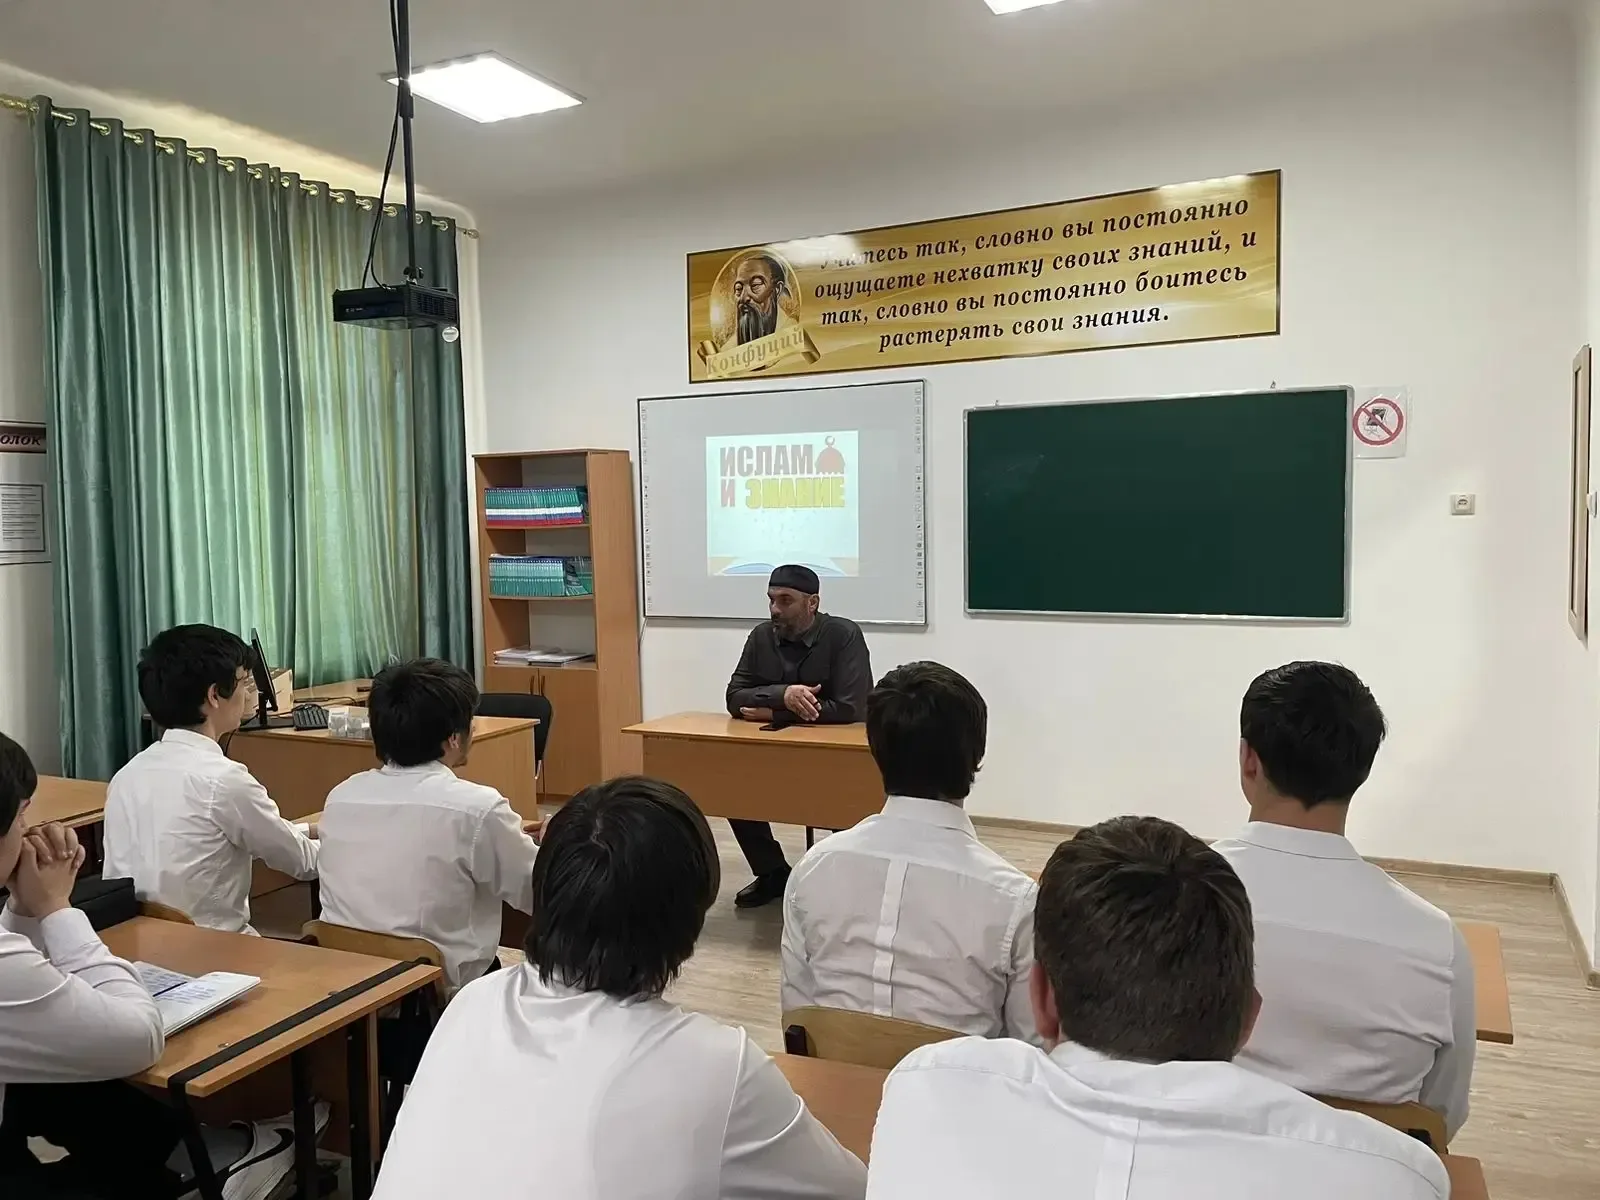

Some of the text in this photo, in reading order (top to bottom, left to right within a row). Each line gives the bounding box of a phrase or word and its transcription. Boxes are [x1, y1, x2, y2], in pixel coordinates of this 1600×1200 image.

[916, 239, 966, 257] так,
[975, 226, 1054, 249] словно
[1062, 221, 1094, 238] вы
[1102, 199, 1249, 233] постоянно
[815, 229, 1257, 300] ощущаете нехватку своих знаний, и
[822, 265, 1247, 326] так, словно вы постоянно боитесь
[707, 326, 803, 374] Конфуций
[878, 306, 1169, 353] растерять свои знания.
[720, 444, 813, 477] ИСЛАМ
[720, 476, 846, 509] И ЗНАНИЕ
